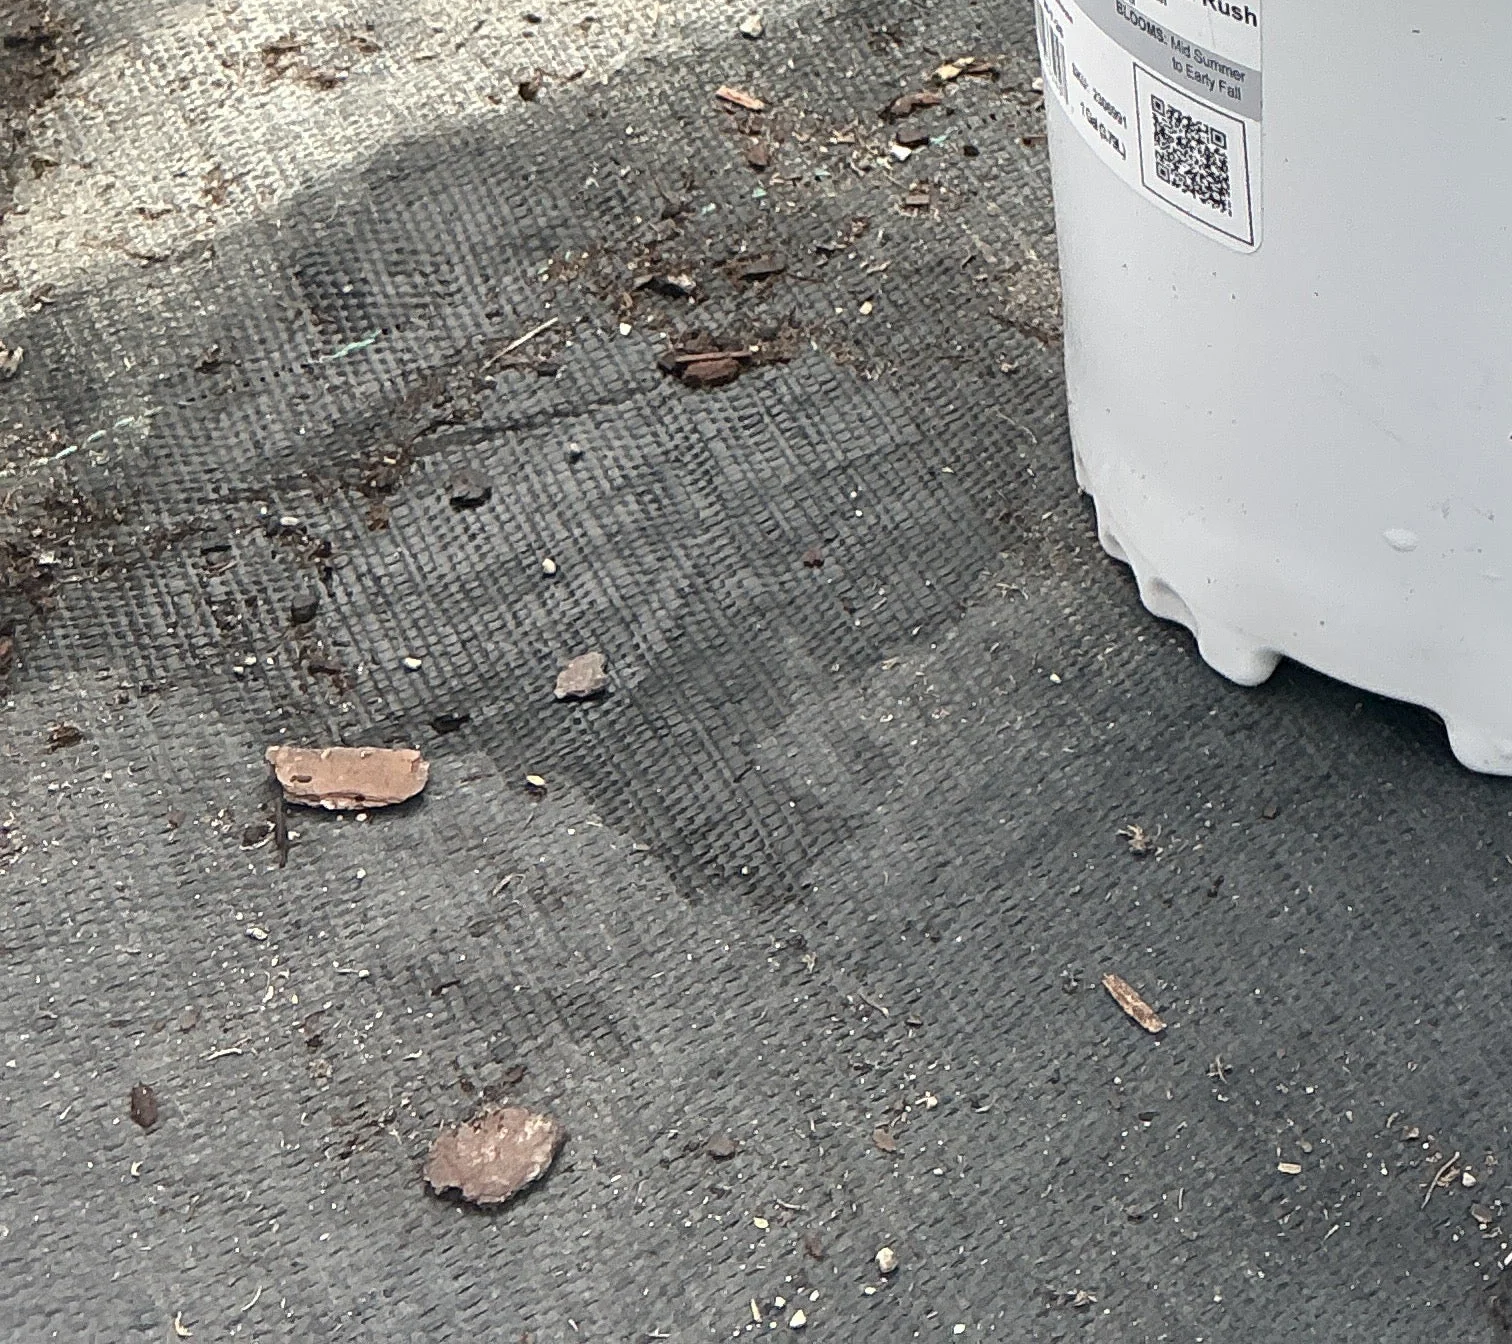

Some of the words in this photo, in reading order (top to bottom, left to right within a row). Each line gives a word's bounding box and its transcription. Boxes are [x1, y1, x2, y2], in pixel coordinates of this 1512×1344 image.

[1115, 0, 1168, 46] BLOOMS:
[1170, 35, 1191, 60] Mid
[1193, 48, 1246, 83] Summer
[1171, 55, 1183, 73] to
[1186, 62, 1216, 93] Early
[1218, 76, 1242, 101] Fall
